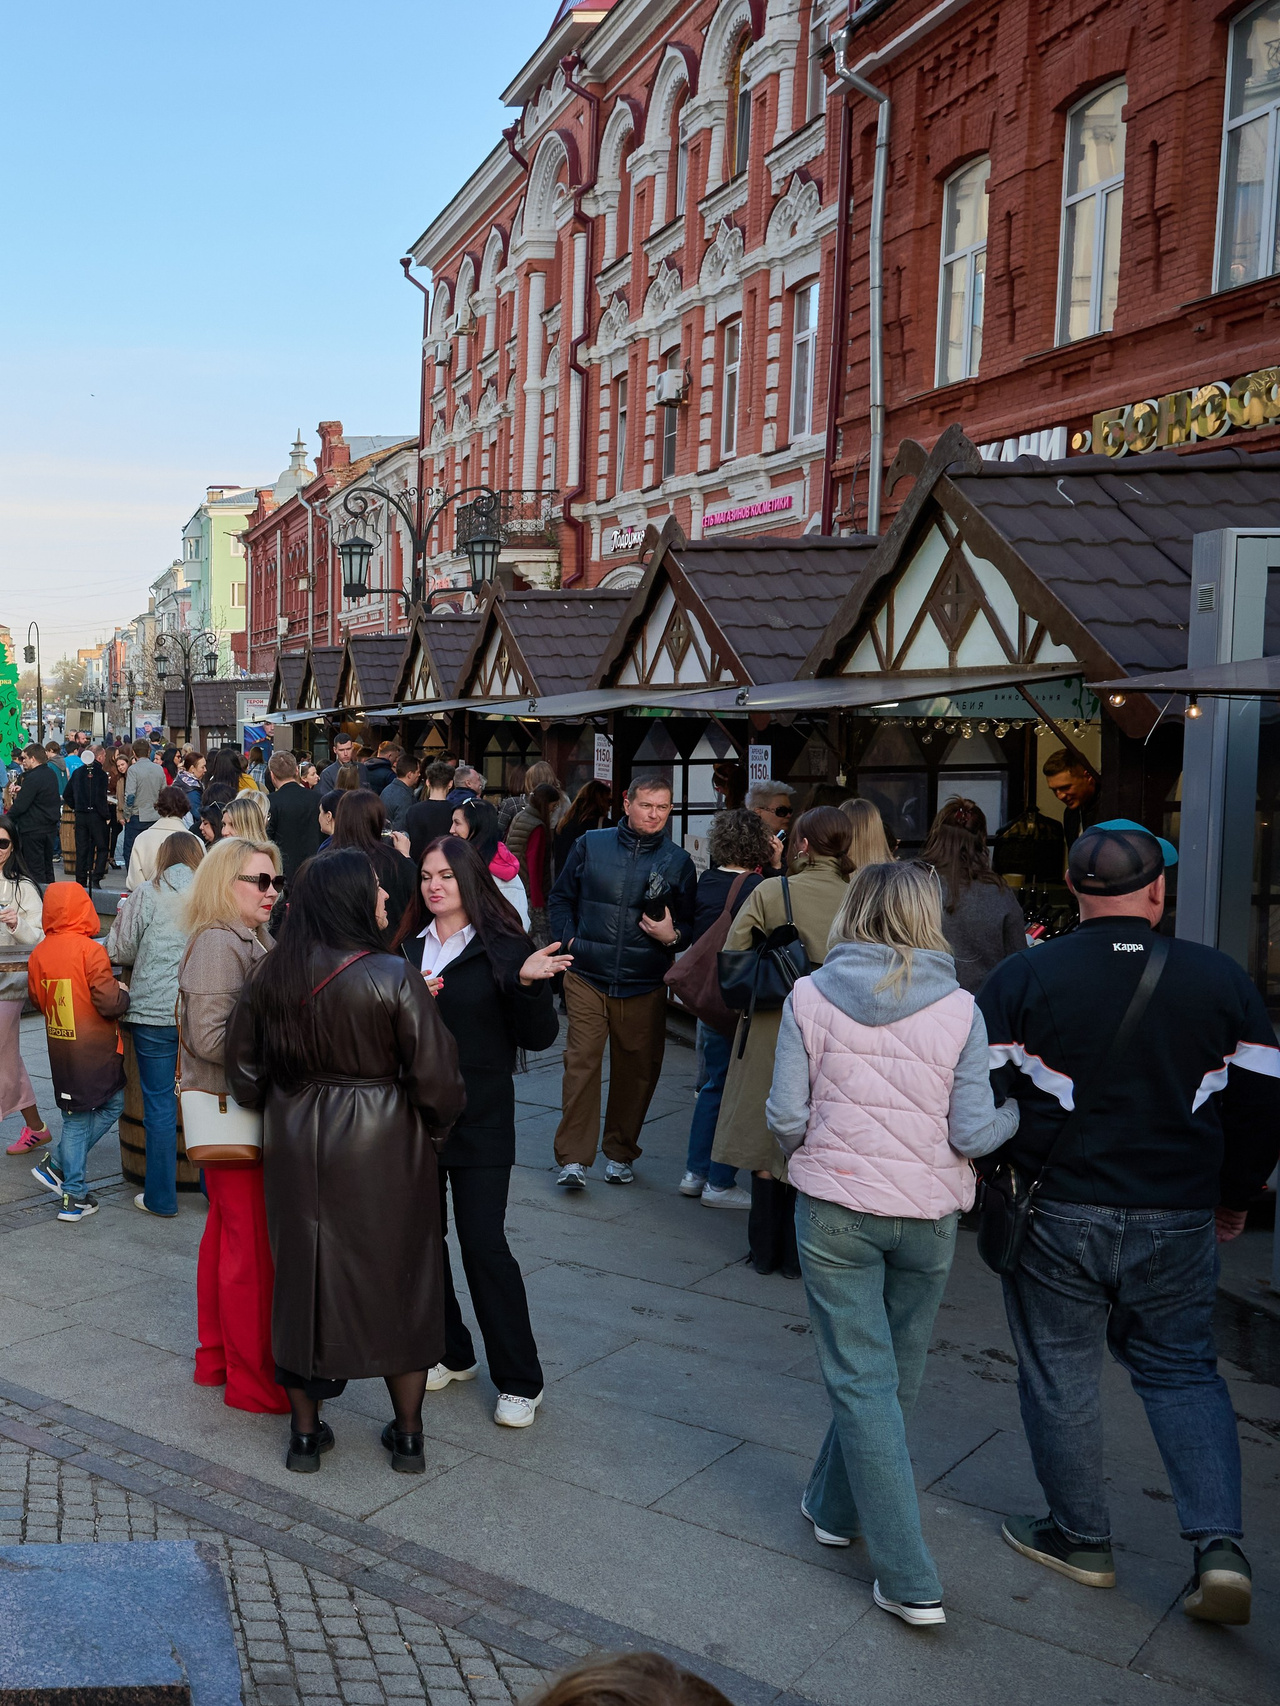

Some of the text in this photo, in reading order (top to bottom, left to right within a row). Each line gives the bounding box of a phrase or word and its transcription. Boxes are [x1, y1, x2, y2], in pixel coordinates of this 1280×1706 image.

[702, 495, 792, 528] СЕТЬ МАГАЗИНОВ КОСМЕТИКИ
[1112, 942, 1144, 953] Kappa
[48, 1026, 73, 1037] SPORT
